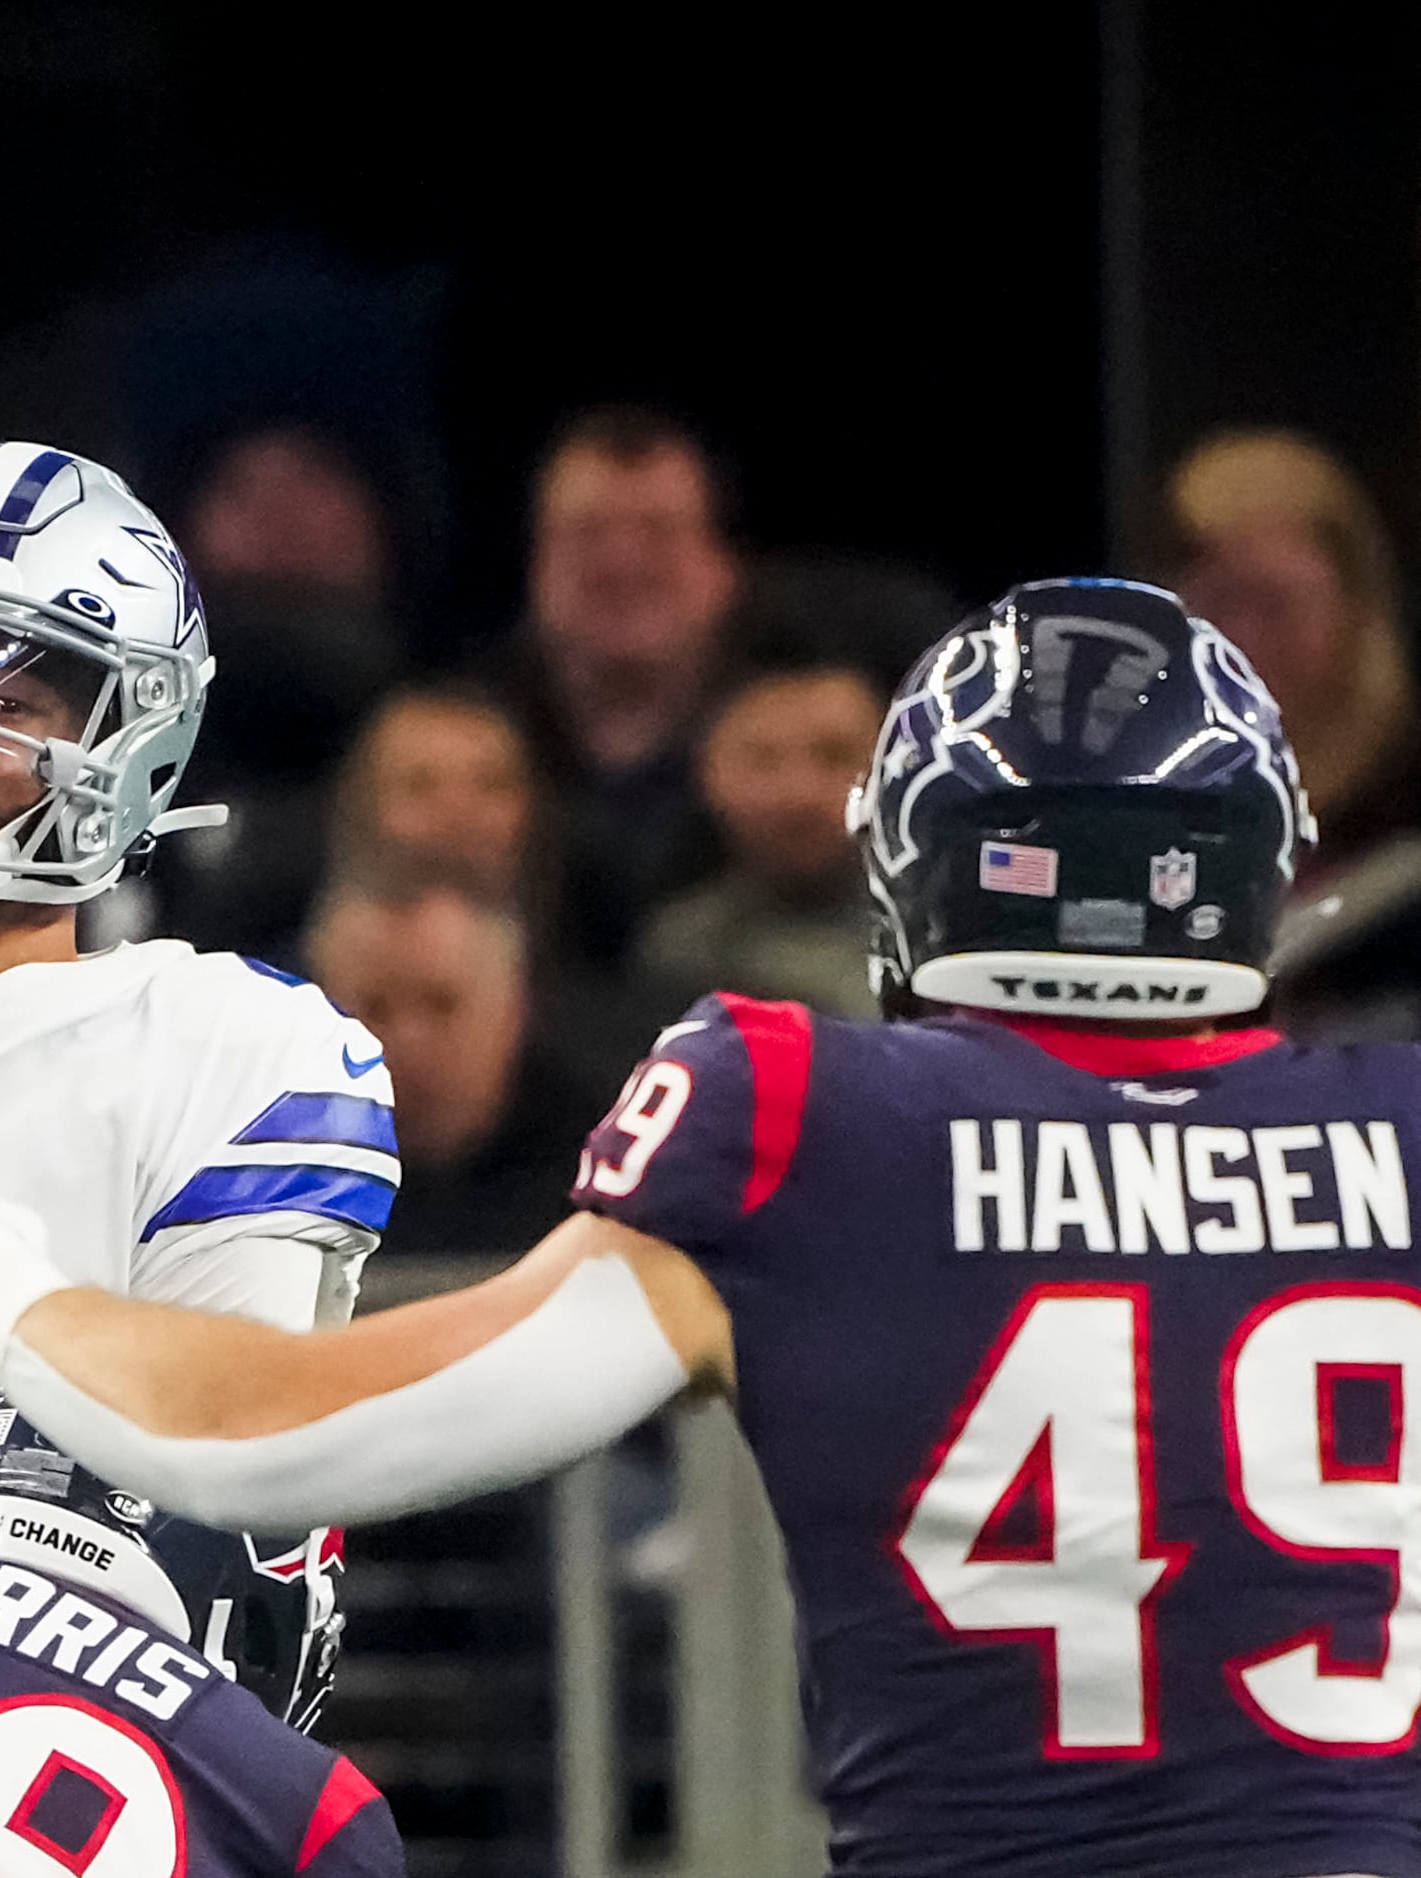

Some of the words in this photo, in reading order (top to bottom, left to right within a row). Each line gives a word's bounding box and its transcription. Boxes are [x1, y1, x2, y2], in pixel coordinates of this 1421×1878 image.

[991, 977, 1208, 1005] TEXANS
[949, 1119, 1412, 1254] HANSEN
[9, 1518, 115, 1571] CHANGE
[896, 1281, 1421, 1760] 49
